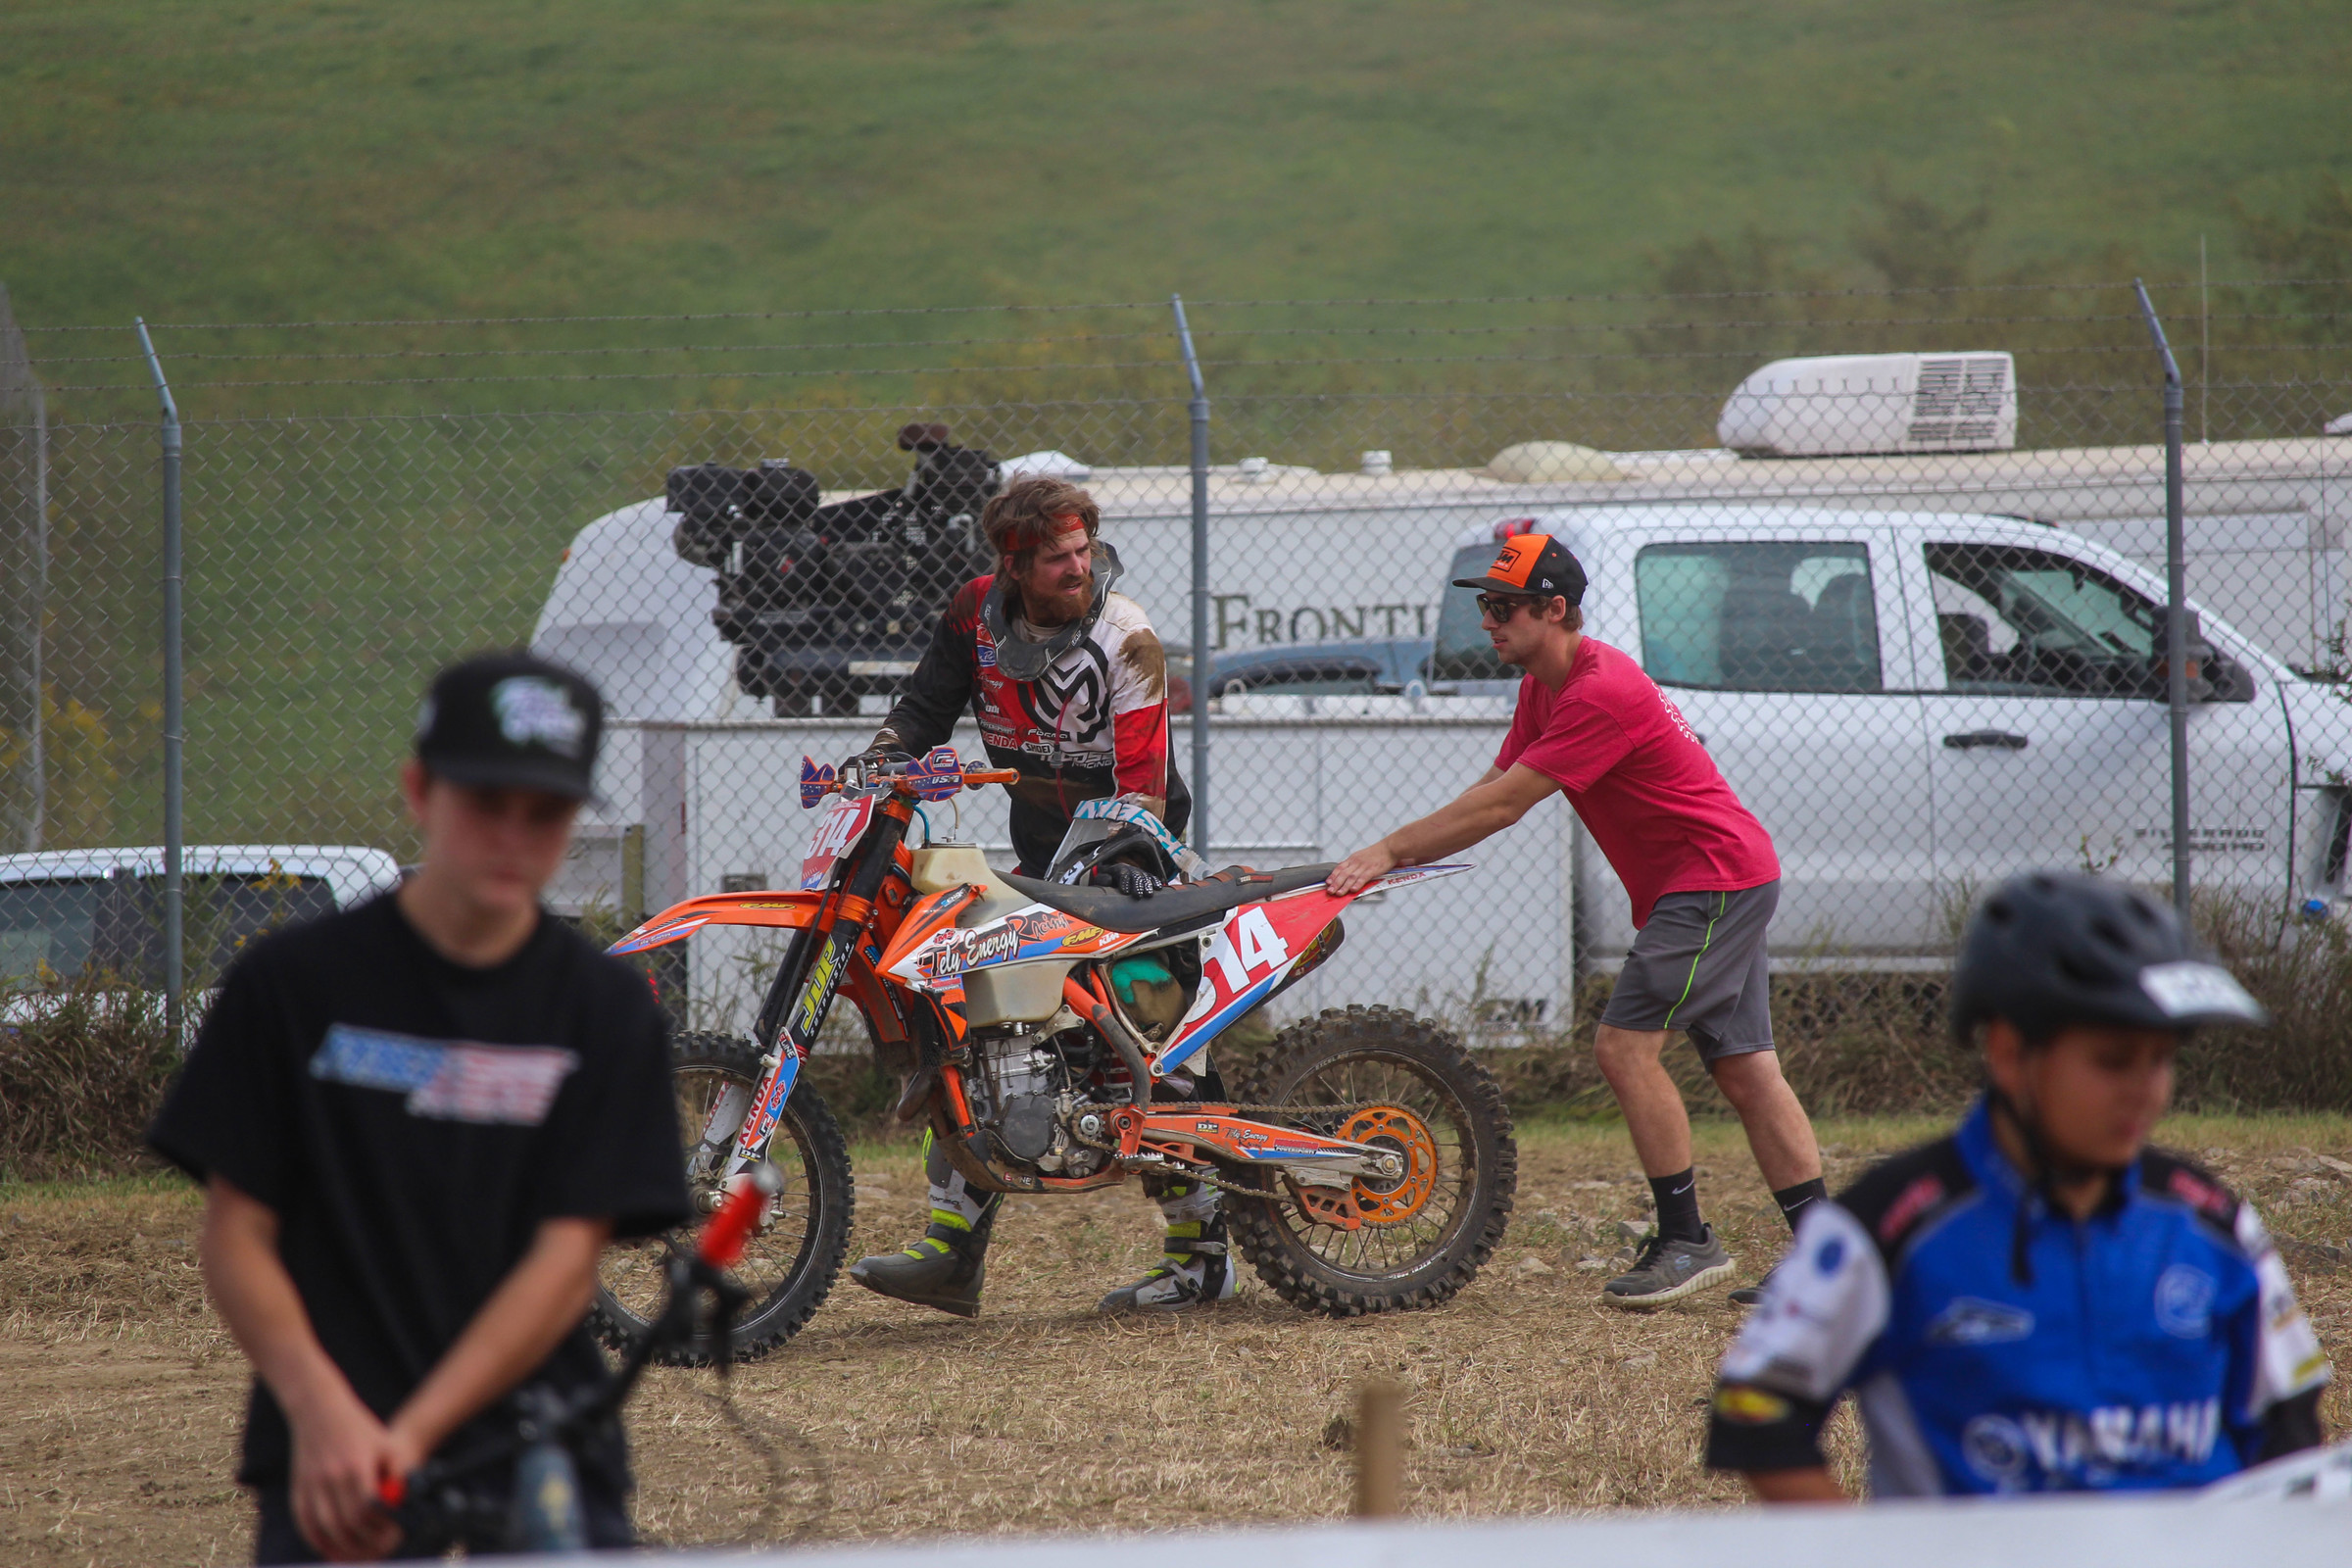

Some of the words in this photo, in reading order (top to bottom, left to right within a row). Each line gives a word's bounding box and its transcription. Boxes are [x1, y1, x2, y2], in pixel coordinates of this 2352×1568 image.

[1210, 594, 1443, 651] FRONTI
[1025, 742, 1053, 755] SHOEI
[1388, 871, 1427, 885] KENDA
[964, 929, 1020, 968] Energy
[1062, 927, 1103, 947] FMF
[1099, 931, 1120, 948] KTM
[802, 935, 839, 1035] JDP
[809, 942, 851, 1038] SUSPENSION
[771, 1081, 786, 1109] IMS
[738, 1076, 772, 1147] KENDA
[1243, 1128, 1269, 1143] Energy
